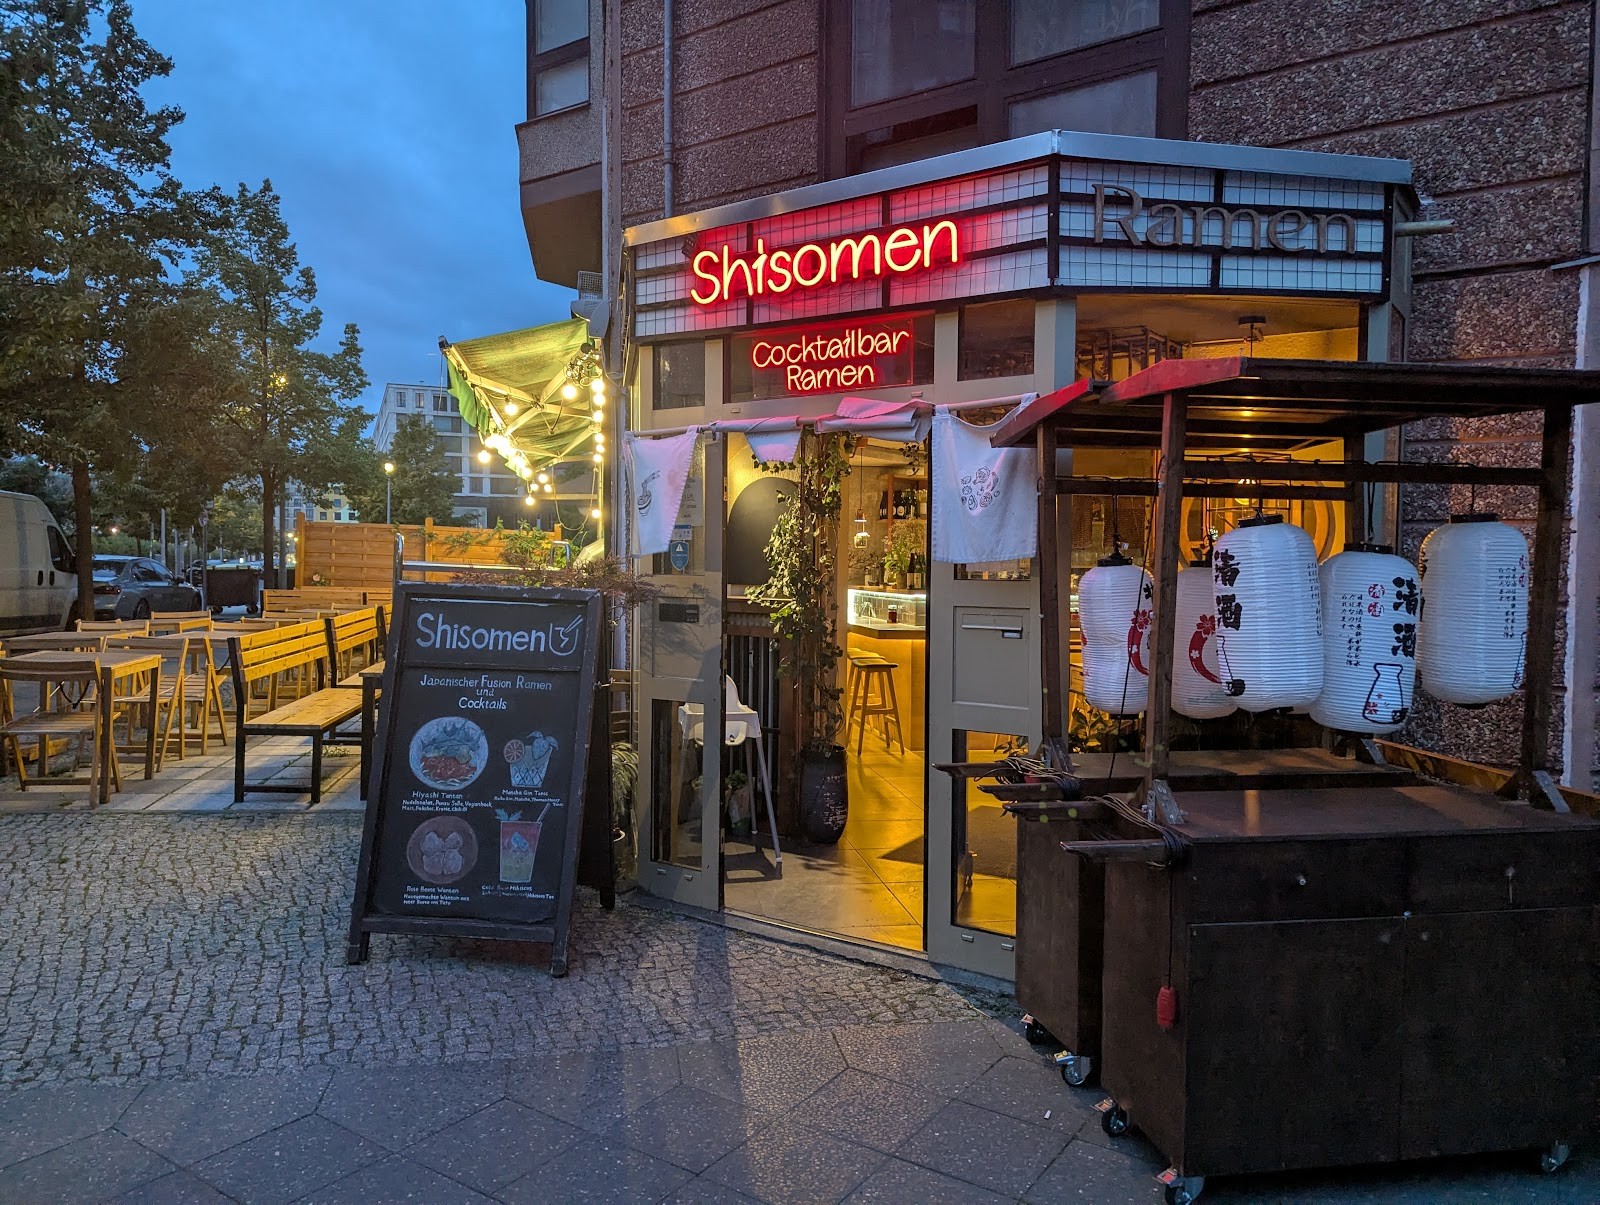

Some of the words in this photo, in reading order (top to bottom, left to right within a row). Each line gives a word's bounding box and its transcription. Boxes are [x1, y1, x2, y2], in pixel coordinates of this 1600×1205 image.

[1091, 182, 1356, 255] Ramen
[690, 220, 958, 304] Shisomen
[752, 328, 910, 368] Cocktailbar
[787, 364, 875, 391] Ramen
[416, 612, 546, 652] Shisomen
[420, 674, 478, 688] Japanischer
[481, 674, 512, 688] Fusion
[516, 676, 553, 691] Ramen
[476, 688, 494, 697] und
[458, 697, 507, 710] Cocktails
